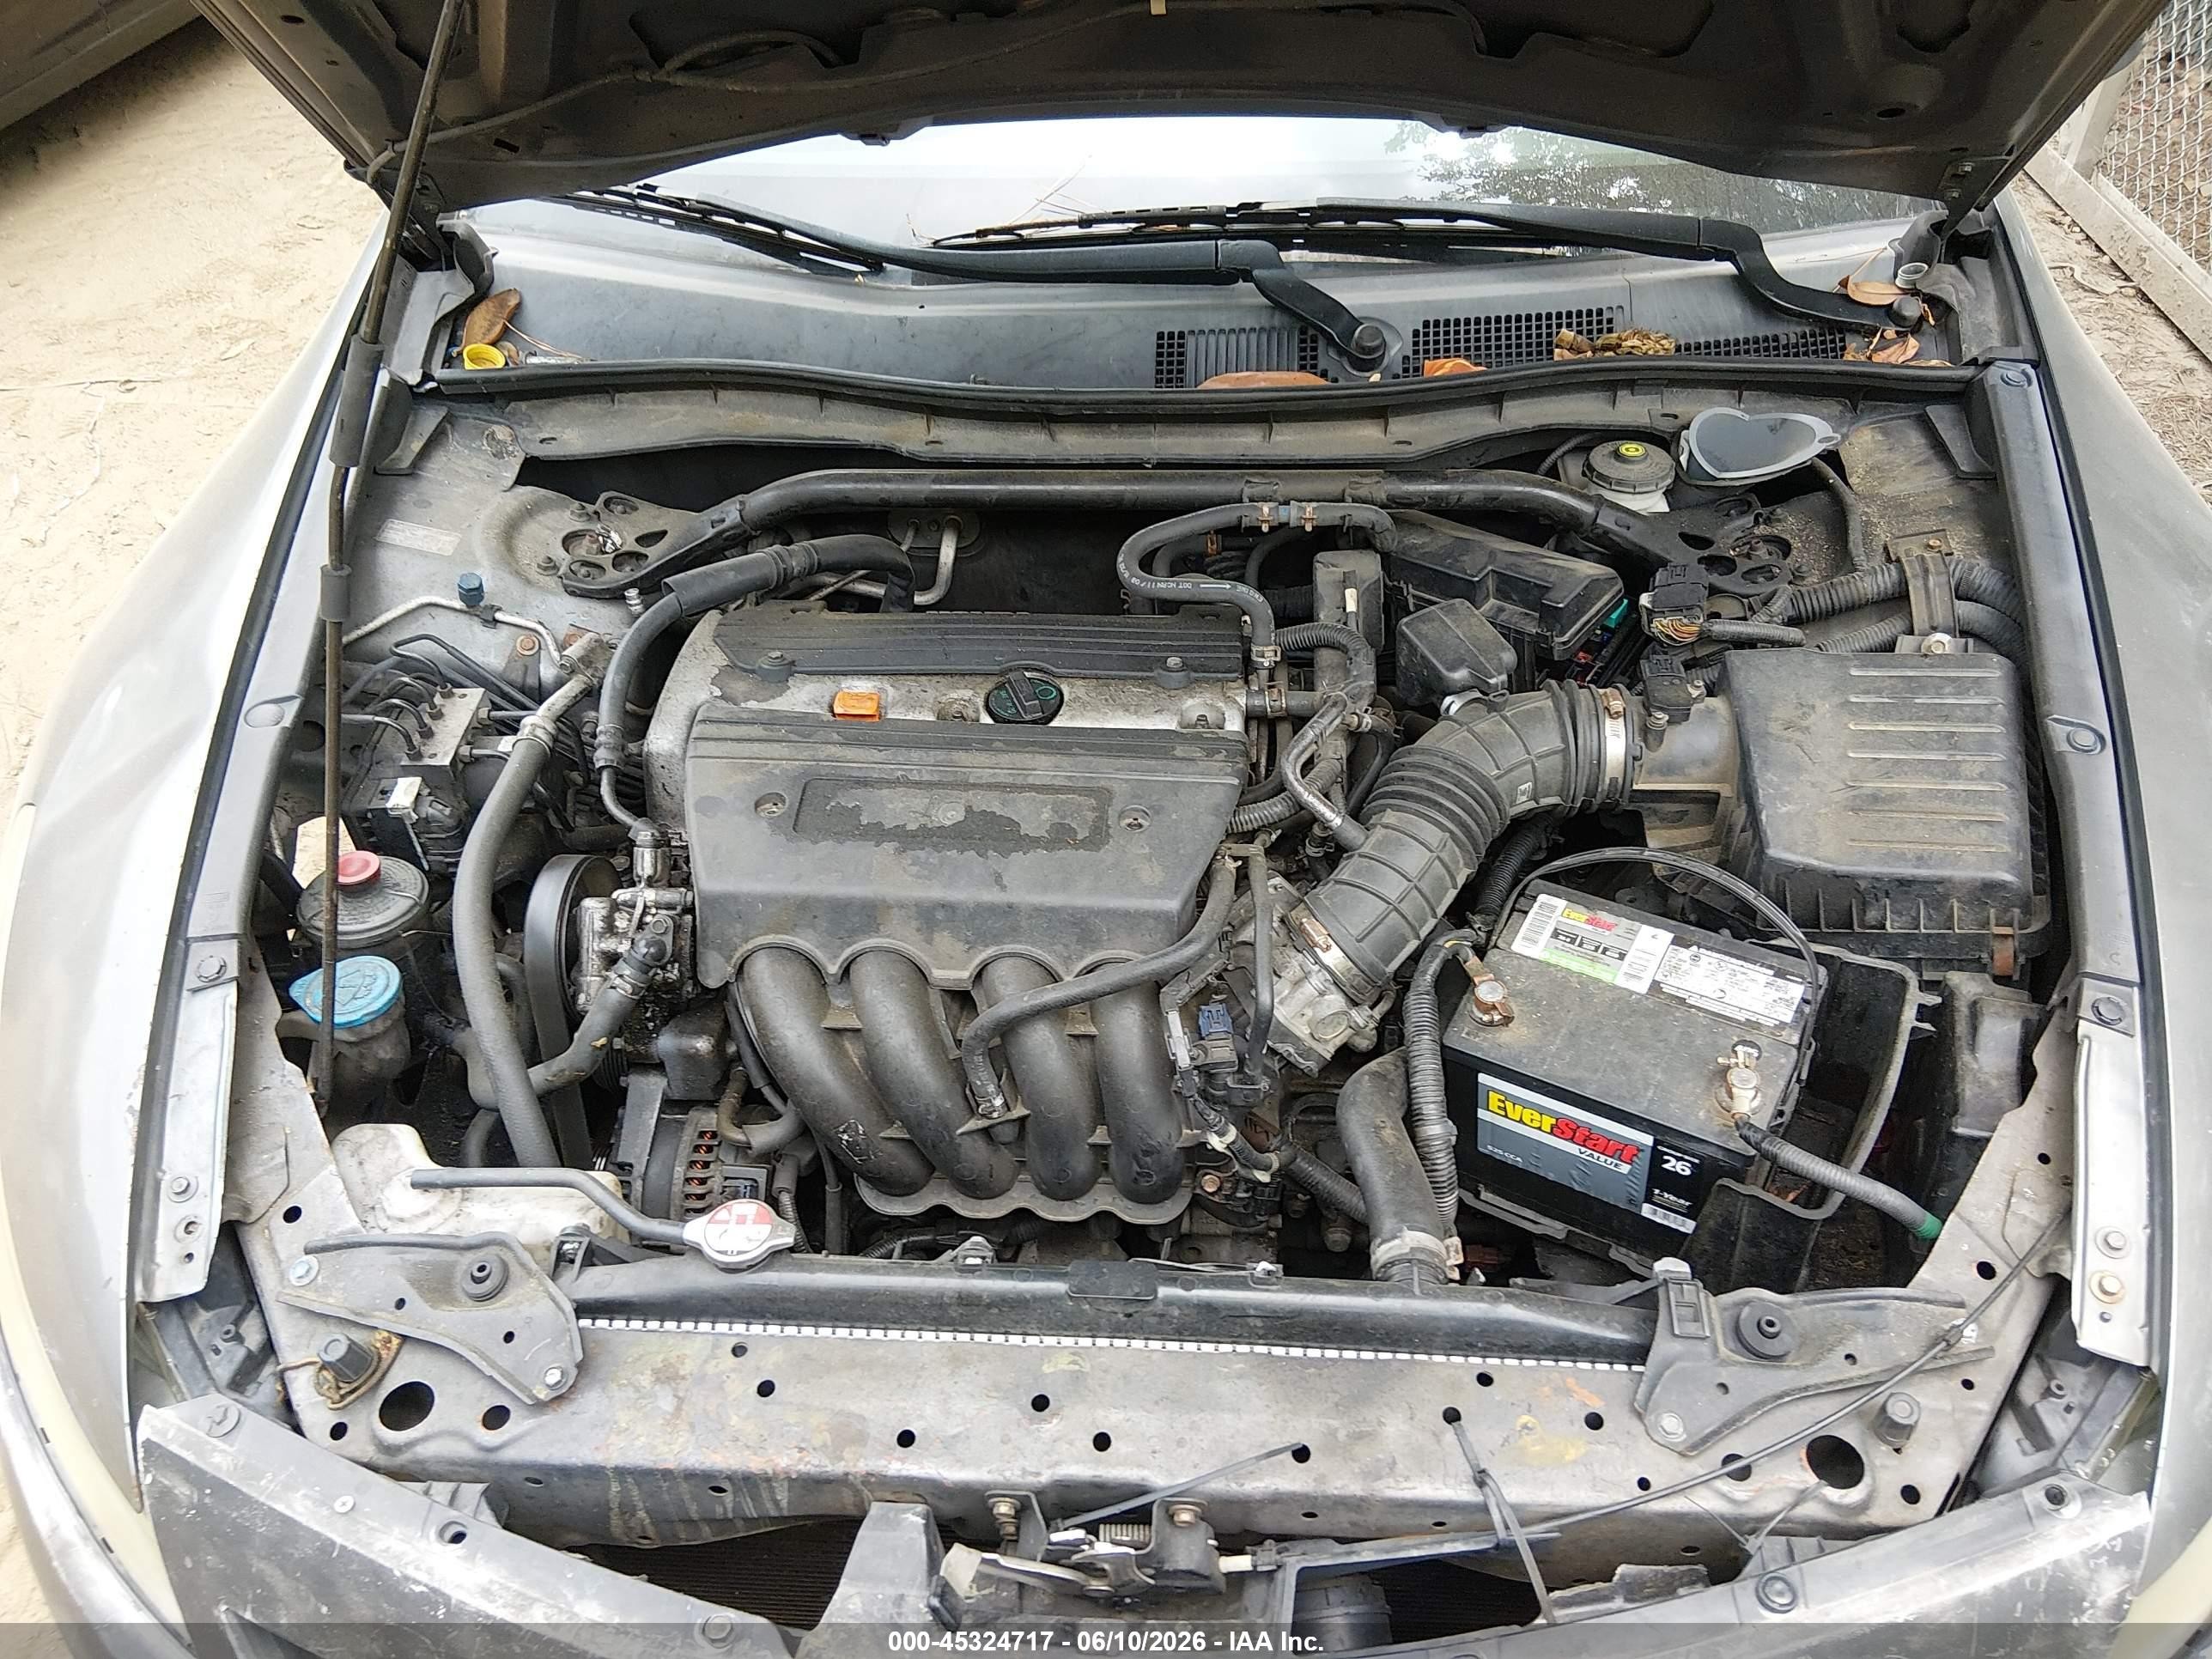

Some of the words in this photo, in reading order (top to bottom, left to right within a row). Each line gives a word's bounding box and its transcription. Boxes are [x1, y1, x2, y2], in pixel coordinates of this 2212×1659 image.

[1487, 1090, 1640, 1165] EverStart
[1578, 1148, 1623, 1170] VALUE
[1661, 1155, 1692, 1176] 26
